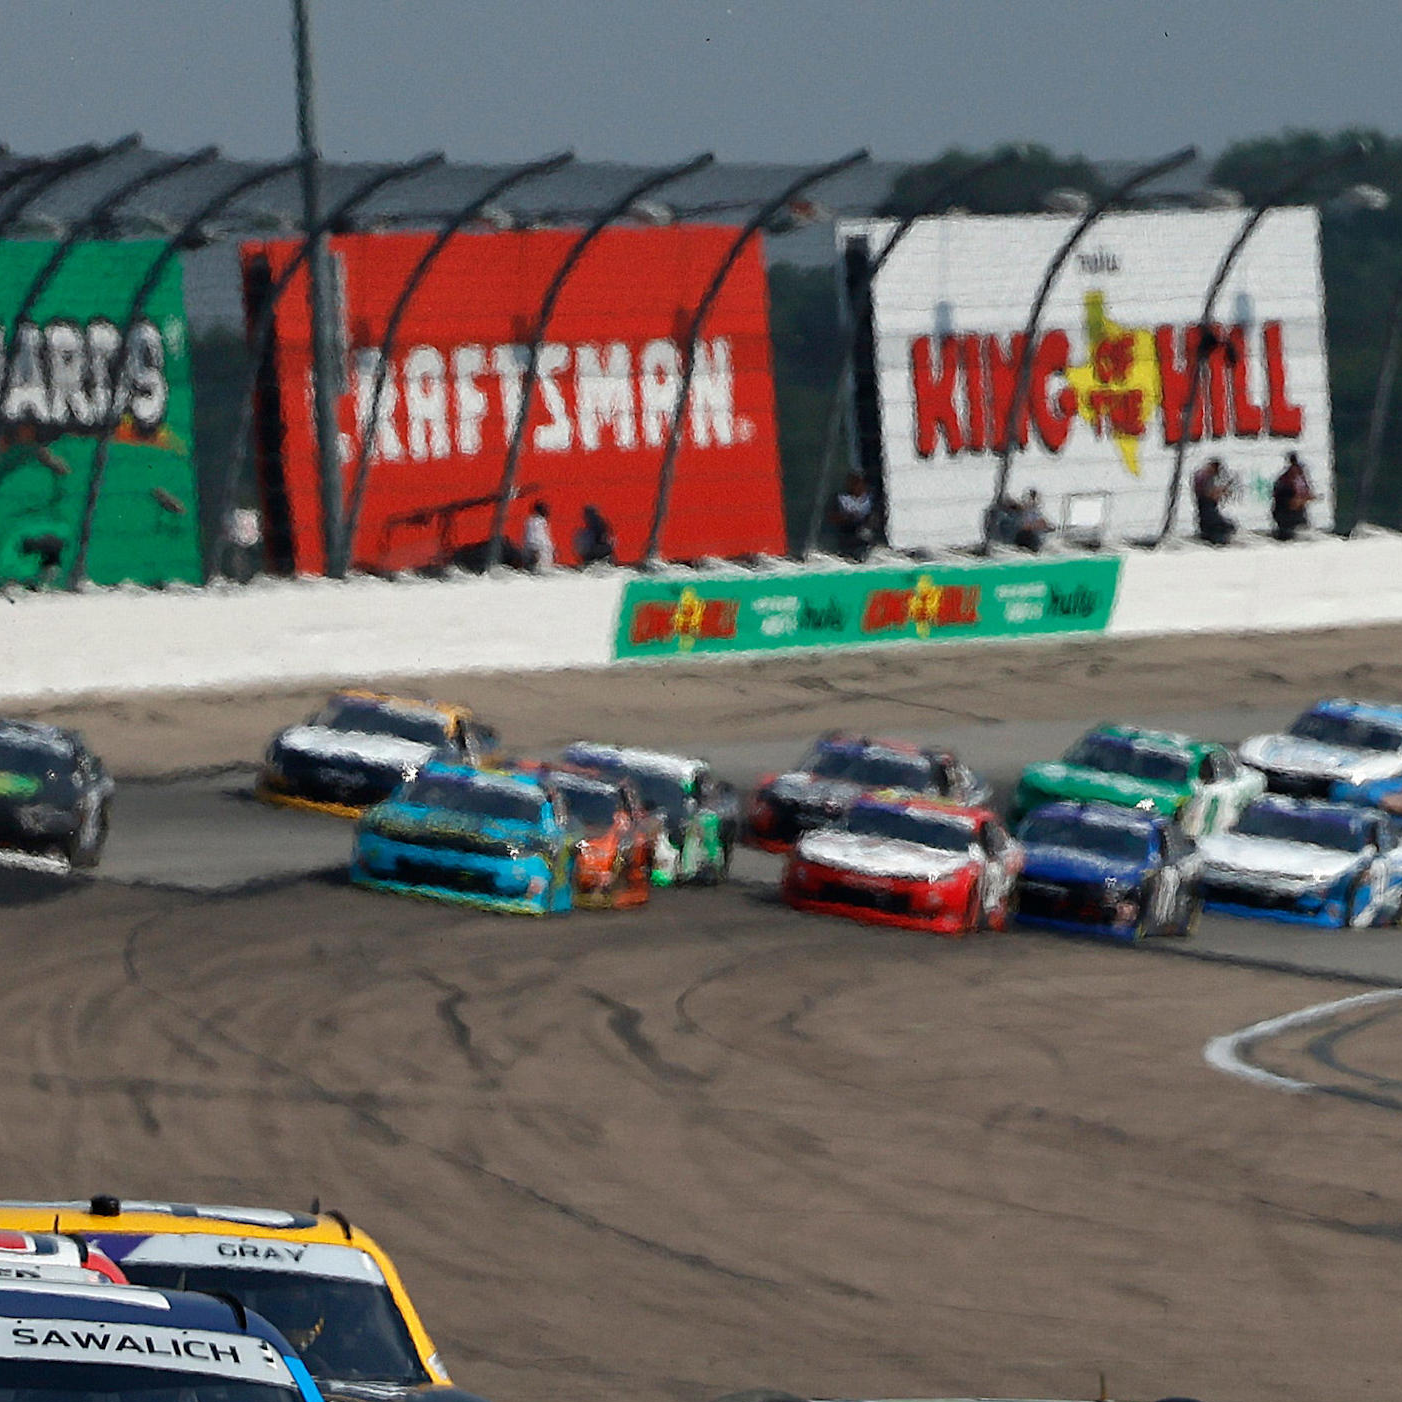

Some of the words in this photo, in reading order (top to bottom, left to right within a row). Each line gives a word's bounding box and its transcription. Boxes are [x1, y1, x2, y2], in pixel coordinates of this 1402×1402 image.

[911, 328, 1077, 457] KING
[217, 1242, 305, 1264] GRAY
[11, 1325, 241, 1365] SAWALICH
